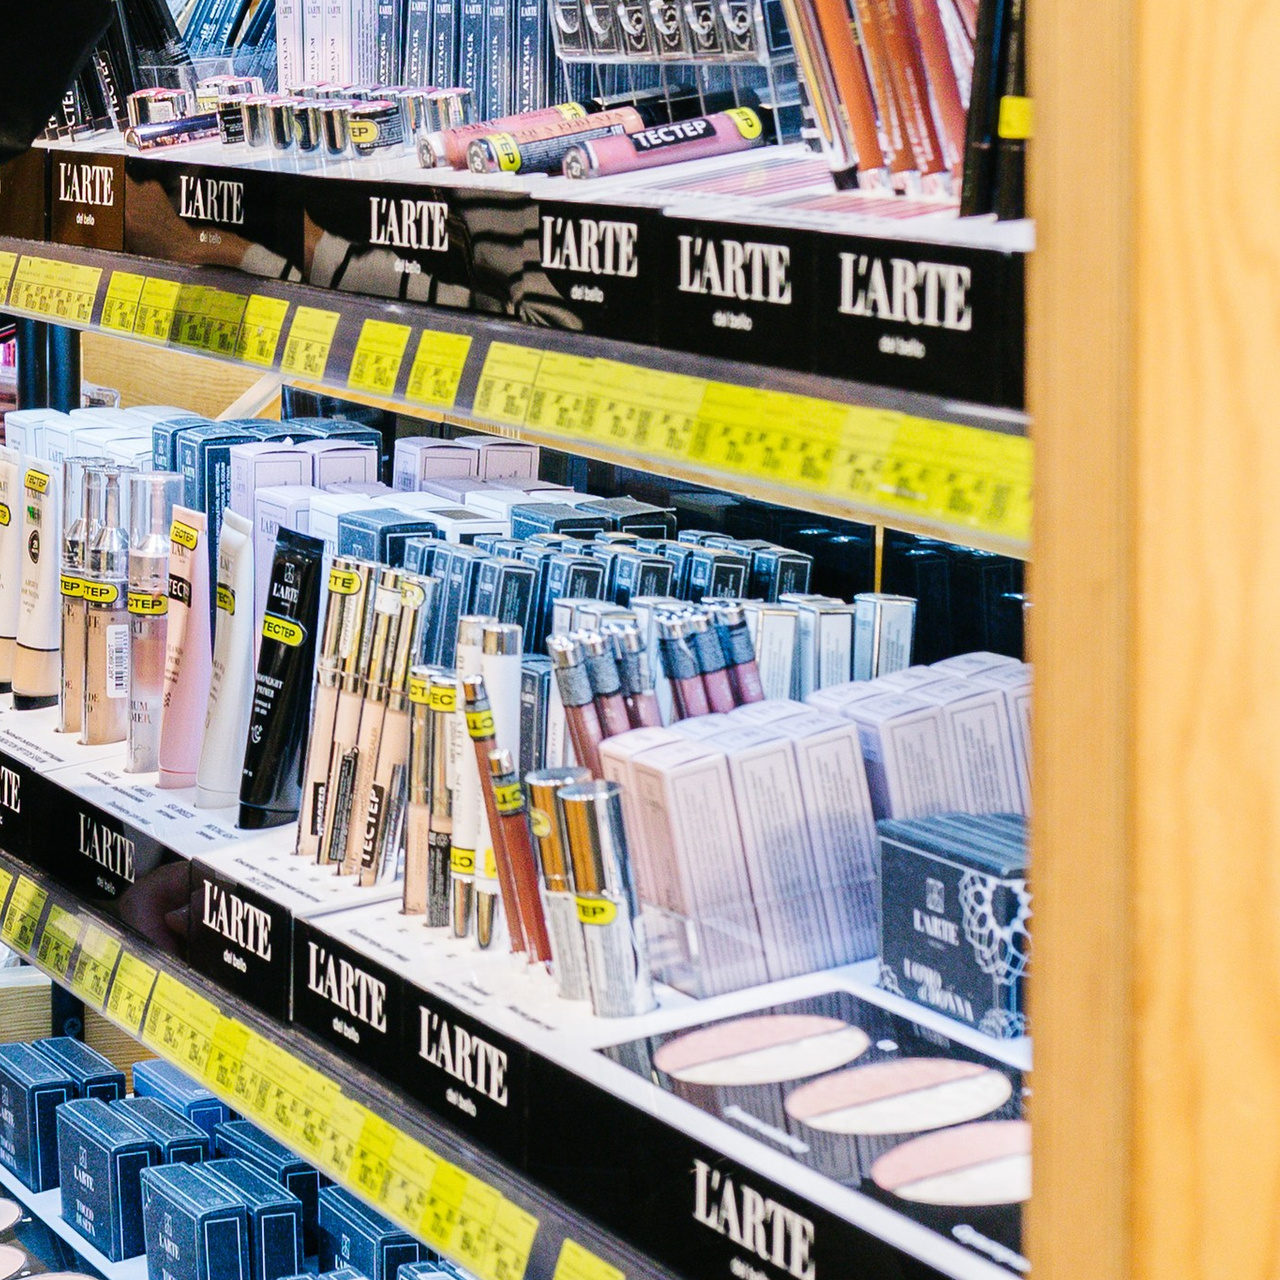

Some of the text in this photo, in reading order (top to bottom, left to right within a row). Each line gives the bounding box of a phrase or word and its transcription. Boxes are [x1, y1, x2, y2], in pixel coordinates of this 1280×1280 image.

[437, 31, 445, 86] ATTACK
[466, 33, 474, 86] ATTACK
[639, 121, 707, 148] ТЕСТЕР
[59, 162, 114, 207] L'ARTE
[179, 175, 244, 225] L'ARTE
[369, 195, 449, 252] L'ARTE
[540, 215, 638, 278] L'ARTE
[677, 235, 792, 305] L'ARTE
[838, 252, 972, 331] L'ARTE
[60, 581, 80, 594] ТЕР
[128, 596, 162, 610] СТЕР
[272, 582, 300, 603] L'ARTE
[263, 619, 296, 639] ТЕСТЕР
[79, 812, 135, 884] L'ARTE
[363, 787, 381, 862] ТЕСТЕР
[203, 879, 272, 962] L'ARTE
[308, 940, 387, 1034] L'ARTE
[419, 1004, 508, 1108] L'ARTE
